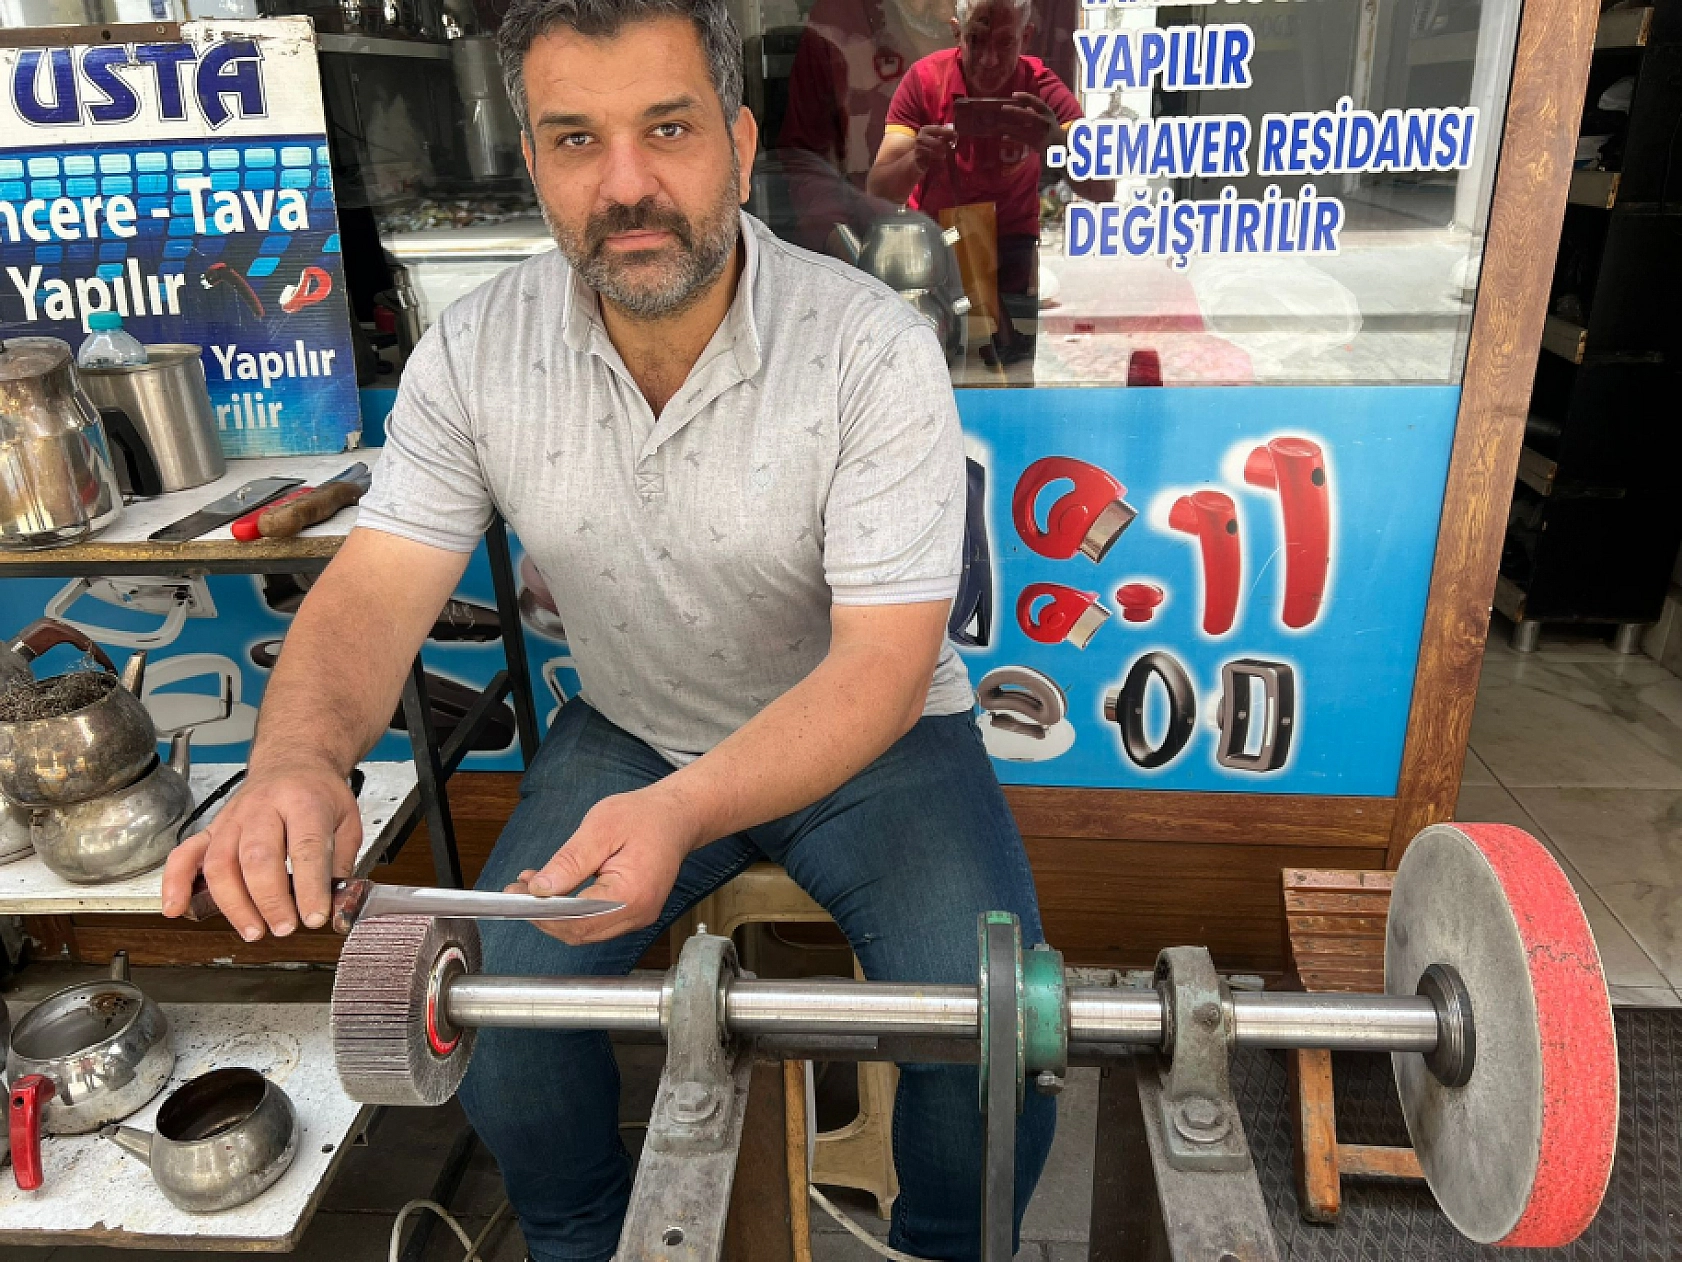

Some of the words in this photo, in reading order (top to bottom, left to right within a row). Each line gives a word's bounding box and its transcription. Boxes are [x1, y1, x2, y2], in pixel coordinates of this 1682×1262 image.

[11, 38, 268, 131] USTA
[1079, 29, 1250, 88] YAPILIR
[1262, 101, 1475, 171] RESİDANSI
[176, 177, 309, 234] Tava
[1069, 187, 1340, 269] DEĞİŞTİRİLİR
[7, 257, 185, 332] Yapılır
[210, 340, 335, 388] Yapılır
[209, 392, 283, 431] rilir
